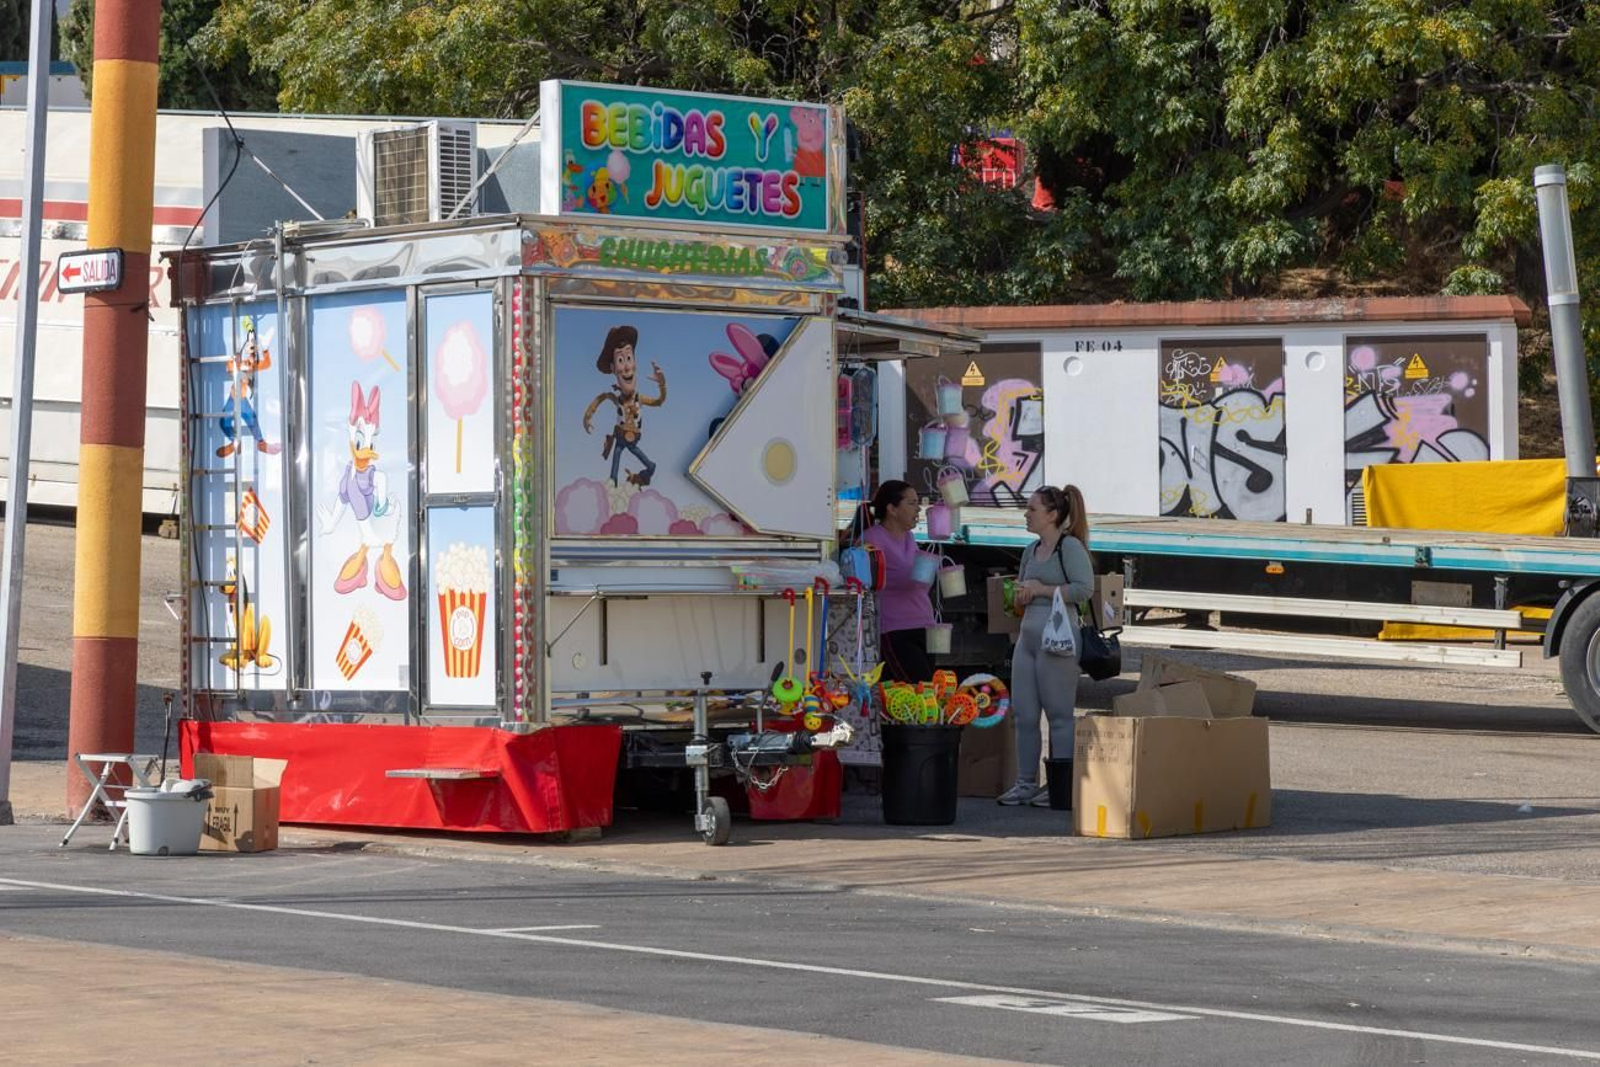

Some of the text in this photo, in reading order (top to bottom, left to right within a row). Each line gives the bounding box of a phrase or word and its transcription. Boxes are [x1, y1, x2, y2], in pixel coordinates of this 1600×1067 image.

[748, 111, 779, 162] Y
[644, 158, 801, 219] JUGUETES
[83, 258, 116, 282] SALIDA
[1075, 339, 1123, 353] FE 04
